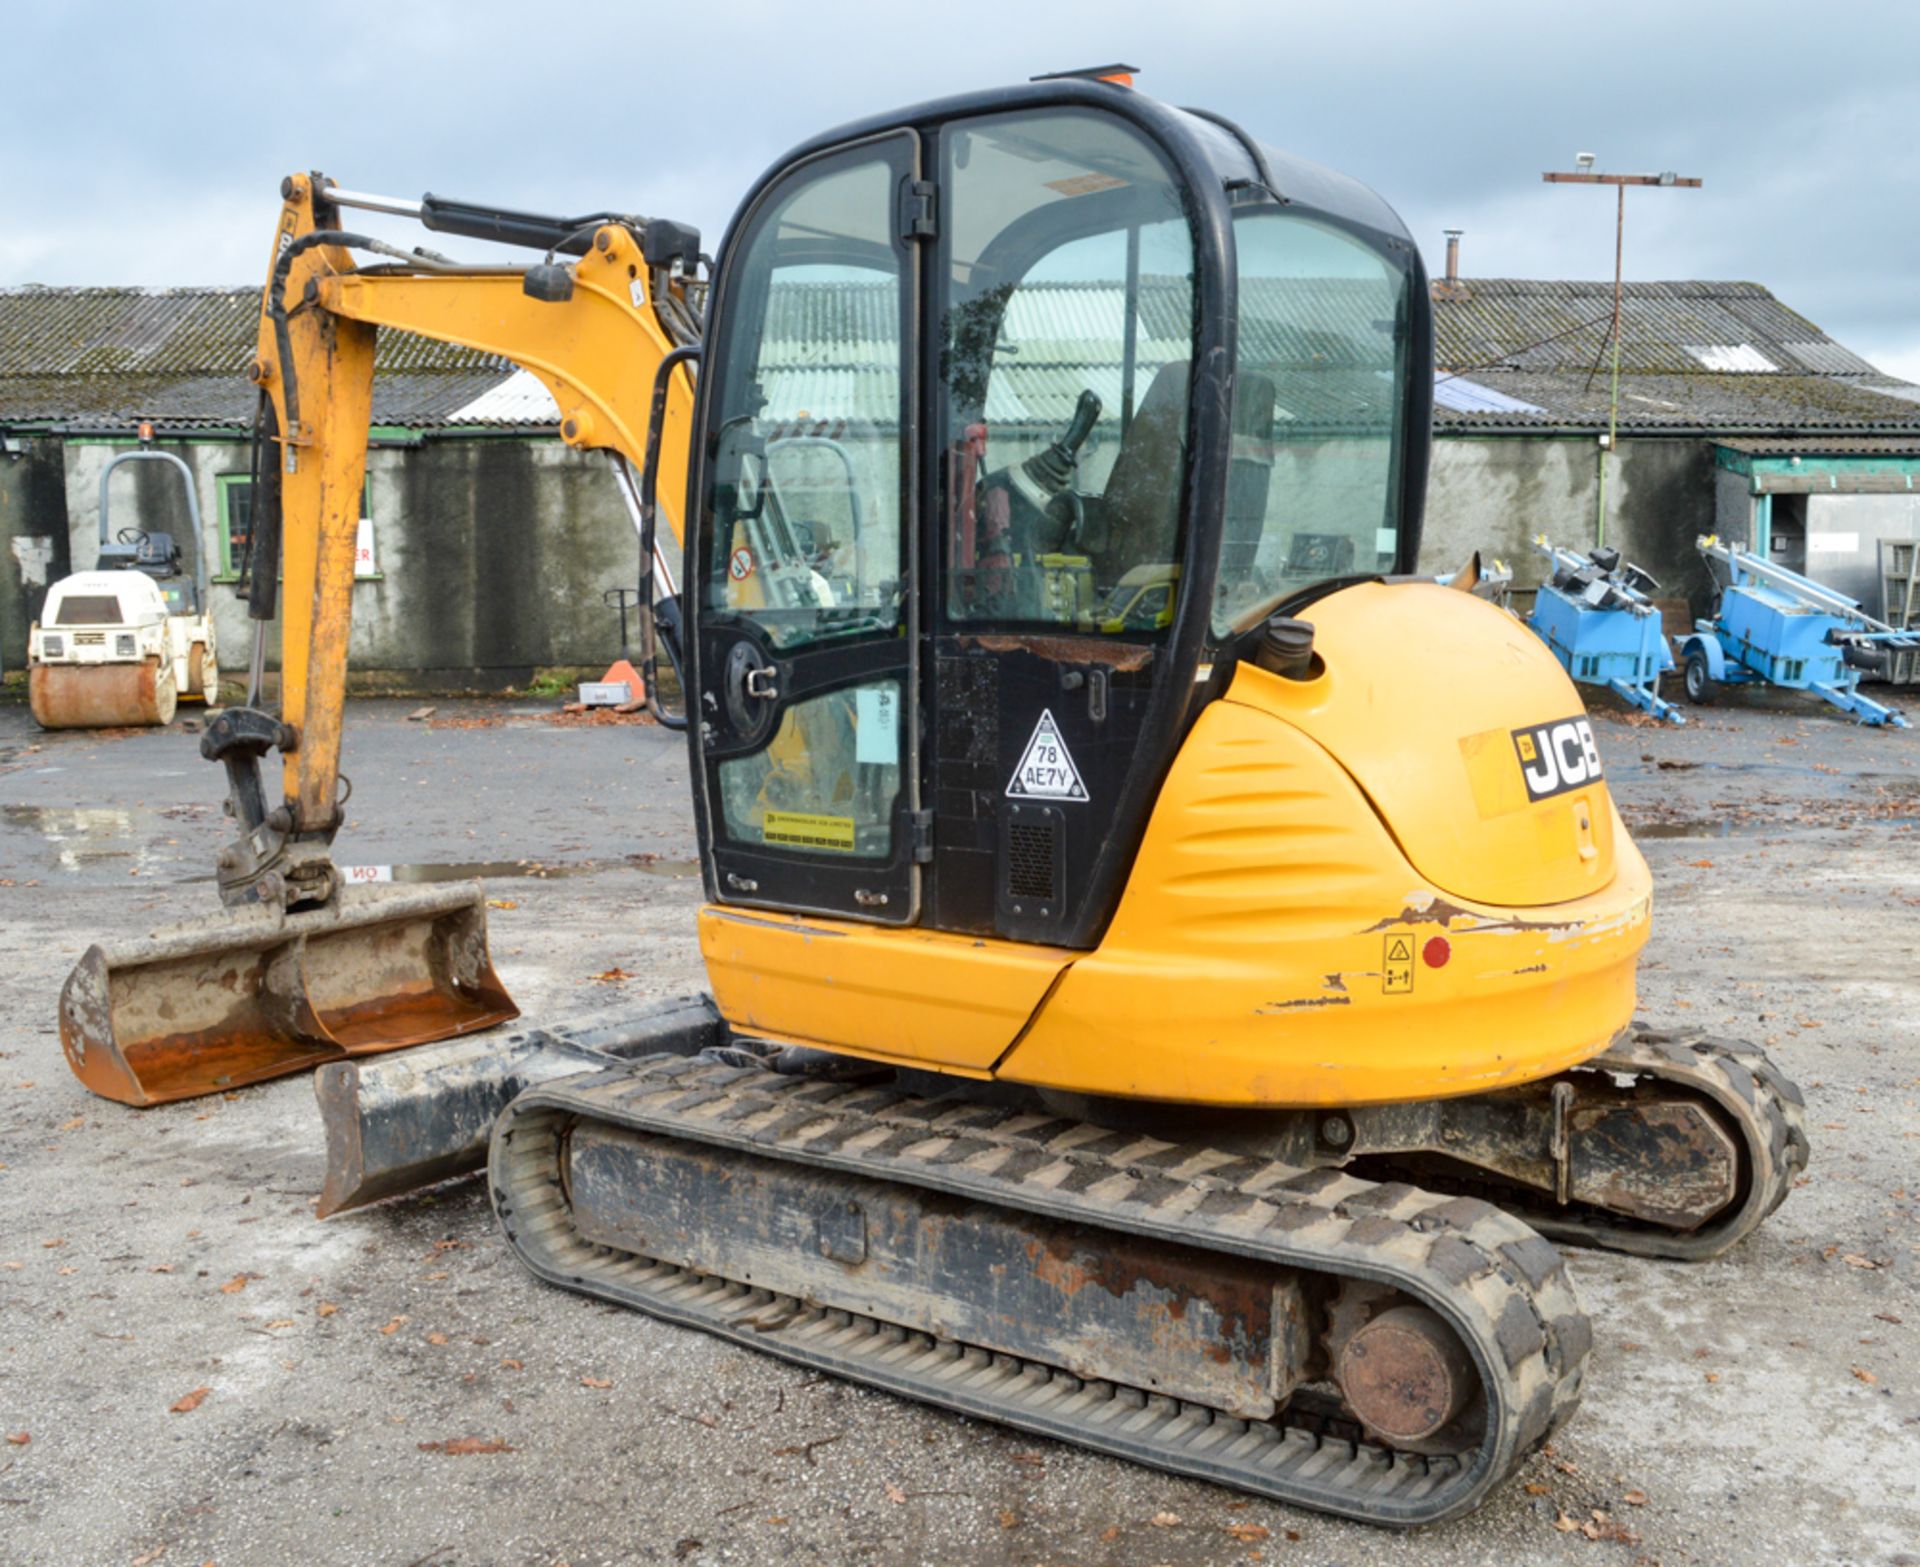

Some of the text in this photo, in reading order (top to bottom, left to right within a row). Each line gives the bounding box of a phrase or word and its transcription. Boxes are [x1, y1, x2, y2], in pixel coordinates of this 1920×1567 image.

[1037, 745, 1057, 764] 78
[1525, 720, 1602, 794] JCB
[1025, 767, 1067, 787] AE7Y
